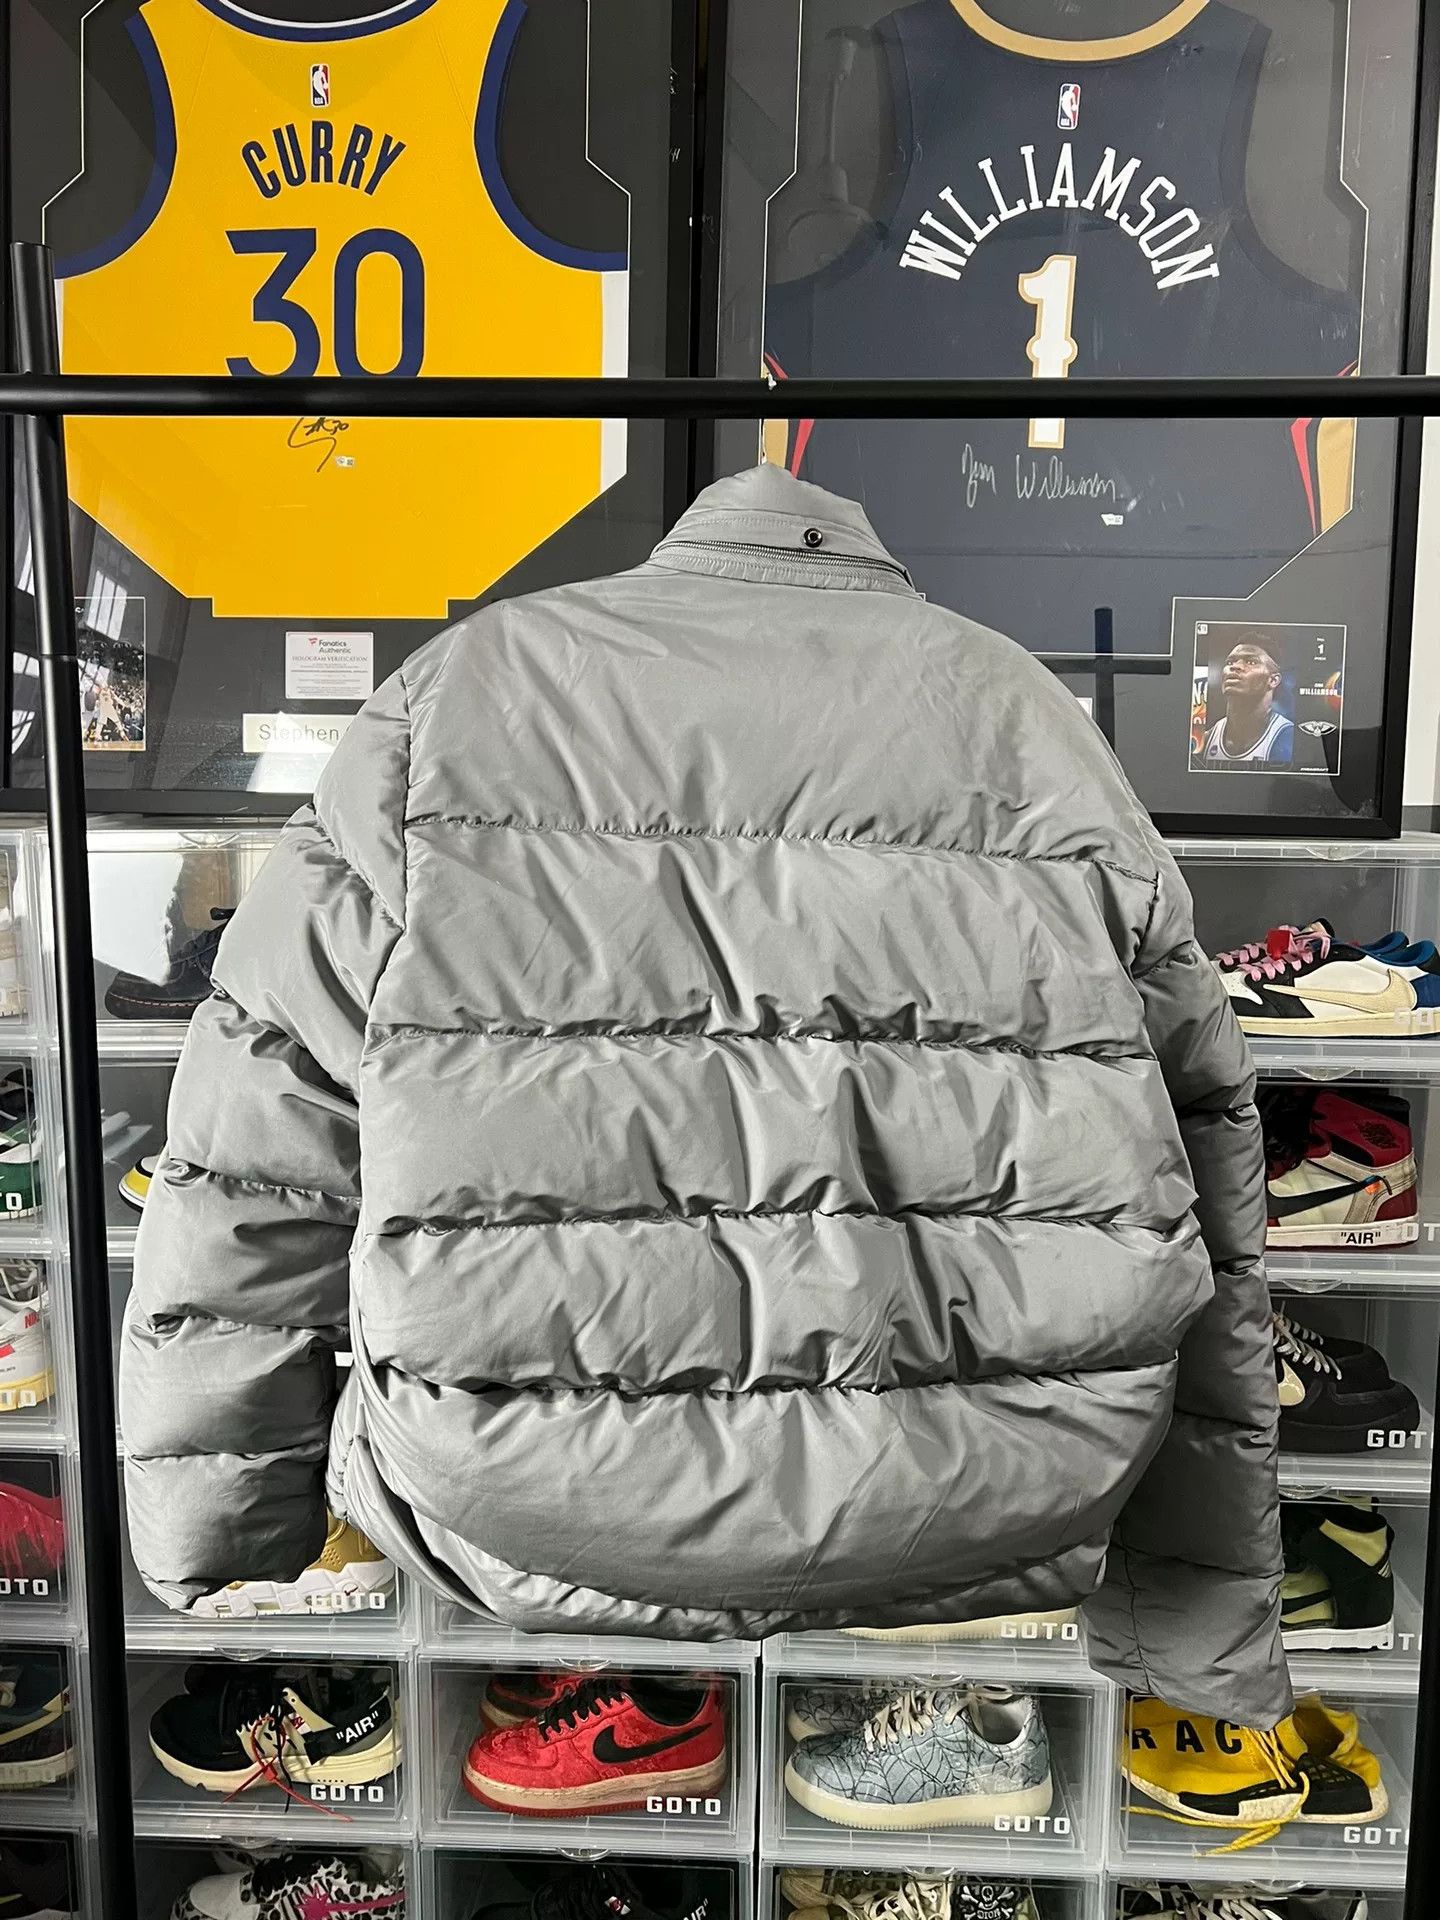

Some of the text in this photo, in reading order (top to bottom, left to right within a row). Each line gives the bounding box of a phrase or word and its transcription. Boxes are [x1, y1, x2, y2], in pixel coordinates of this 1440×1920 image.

[241, 119, 407, 199] CURRY
[898, 142, 1220, 290] WILLIAMSON
[224, 227, 425, 377] 30
[1018, 254, 1079, 449] 1
[319, 639, 347, 647] Fanatics
[259, 723, 339, 742] Stephen
[0, 1192, 22, 1210] O
[1340, 1231, 1381, 1245] "AIR"
[1366, 1429, 1434, 1448] GOT
[1000, 1621, 1078, 1641] GOTO
[335, 1709, 379, 1744] "AIR"
[310, 1783, 384, 1803] GOTO
[646, 1796, 721, 1816] GOTO
[993, 1814, 1071, 1835] GOTO
[1343, 1825, 1409, 1846] GOT
